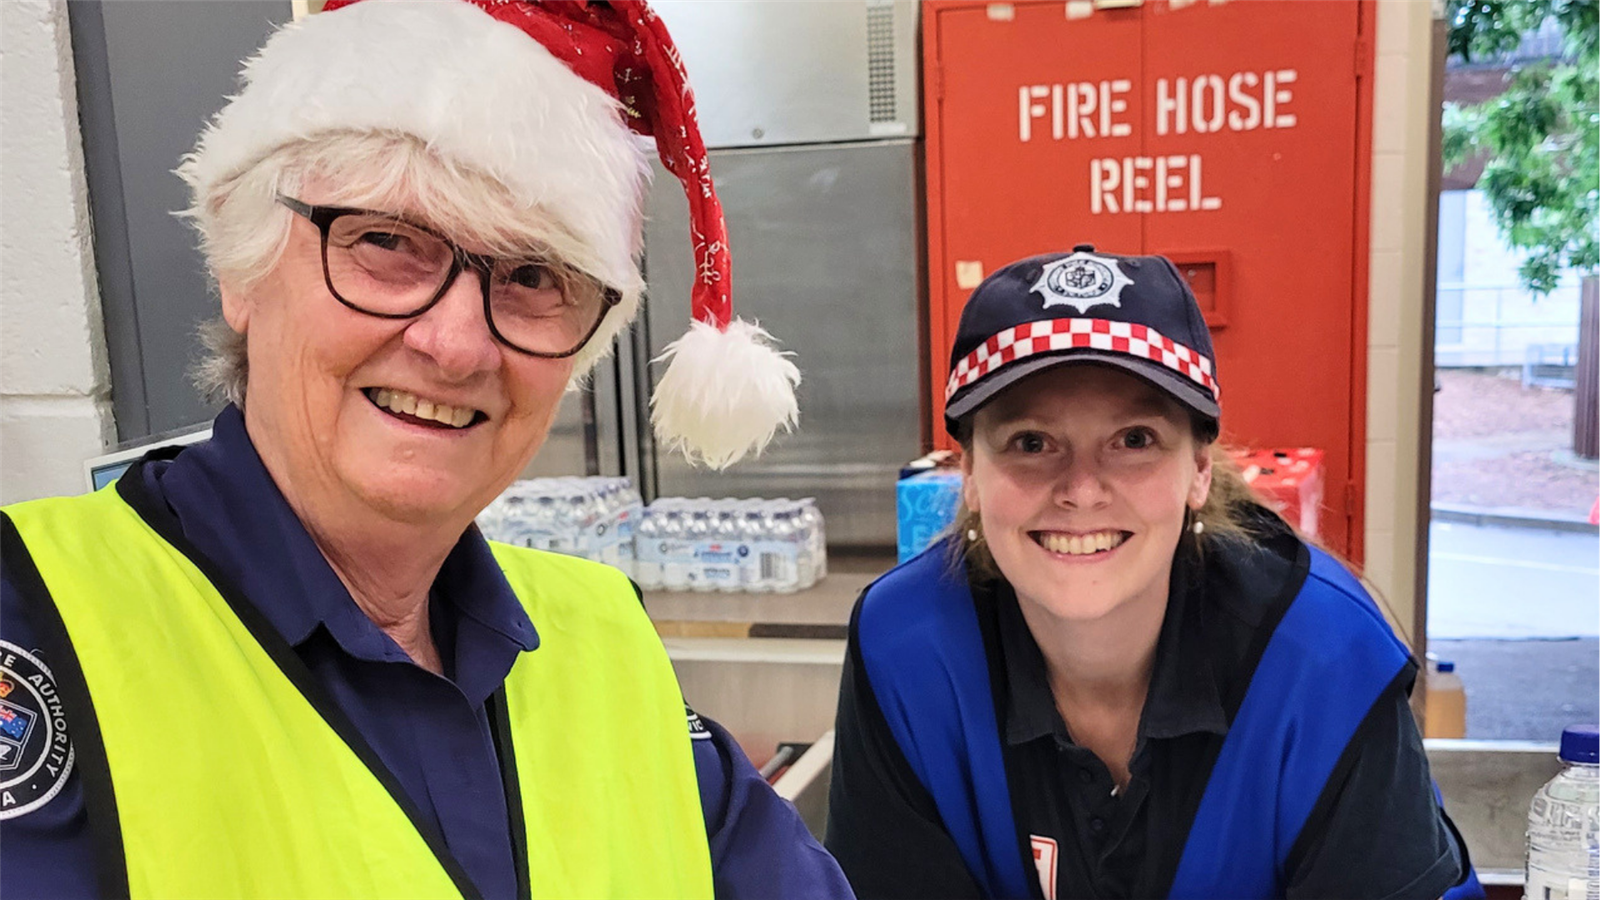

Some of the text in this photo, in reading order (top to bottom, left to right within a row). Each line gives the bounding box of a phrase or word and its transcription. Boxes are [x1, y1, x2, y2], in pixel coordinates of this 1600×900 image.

[1019, 69, 1298, 142] FIRE HOSE
[1090, 154, 1222, 214] REEL
[28, 674, 67, 778] AUTHORITY
